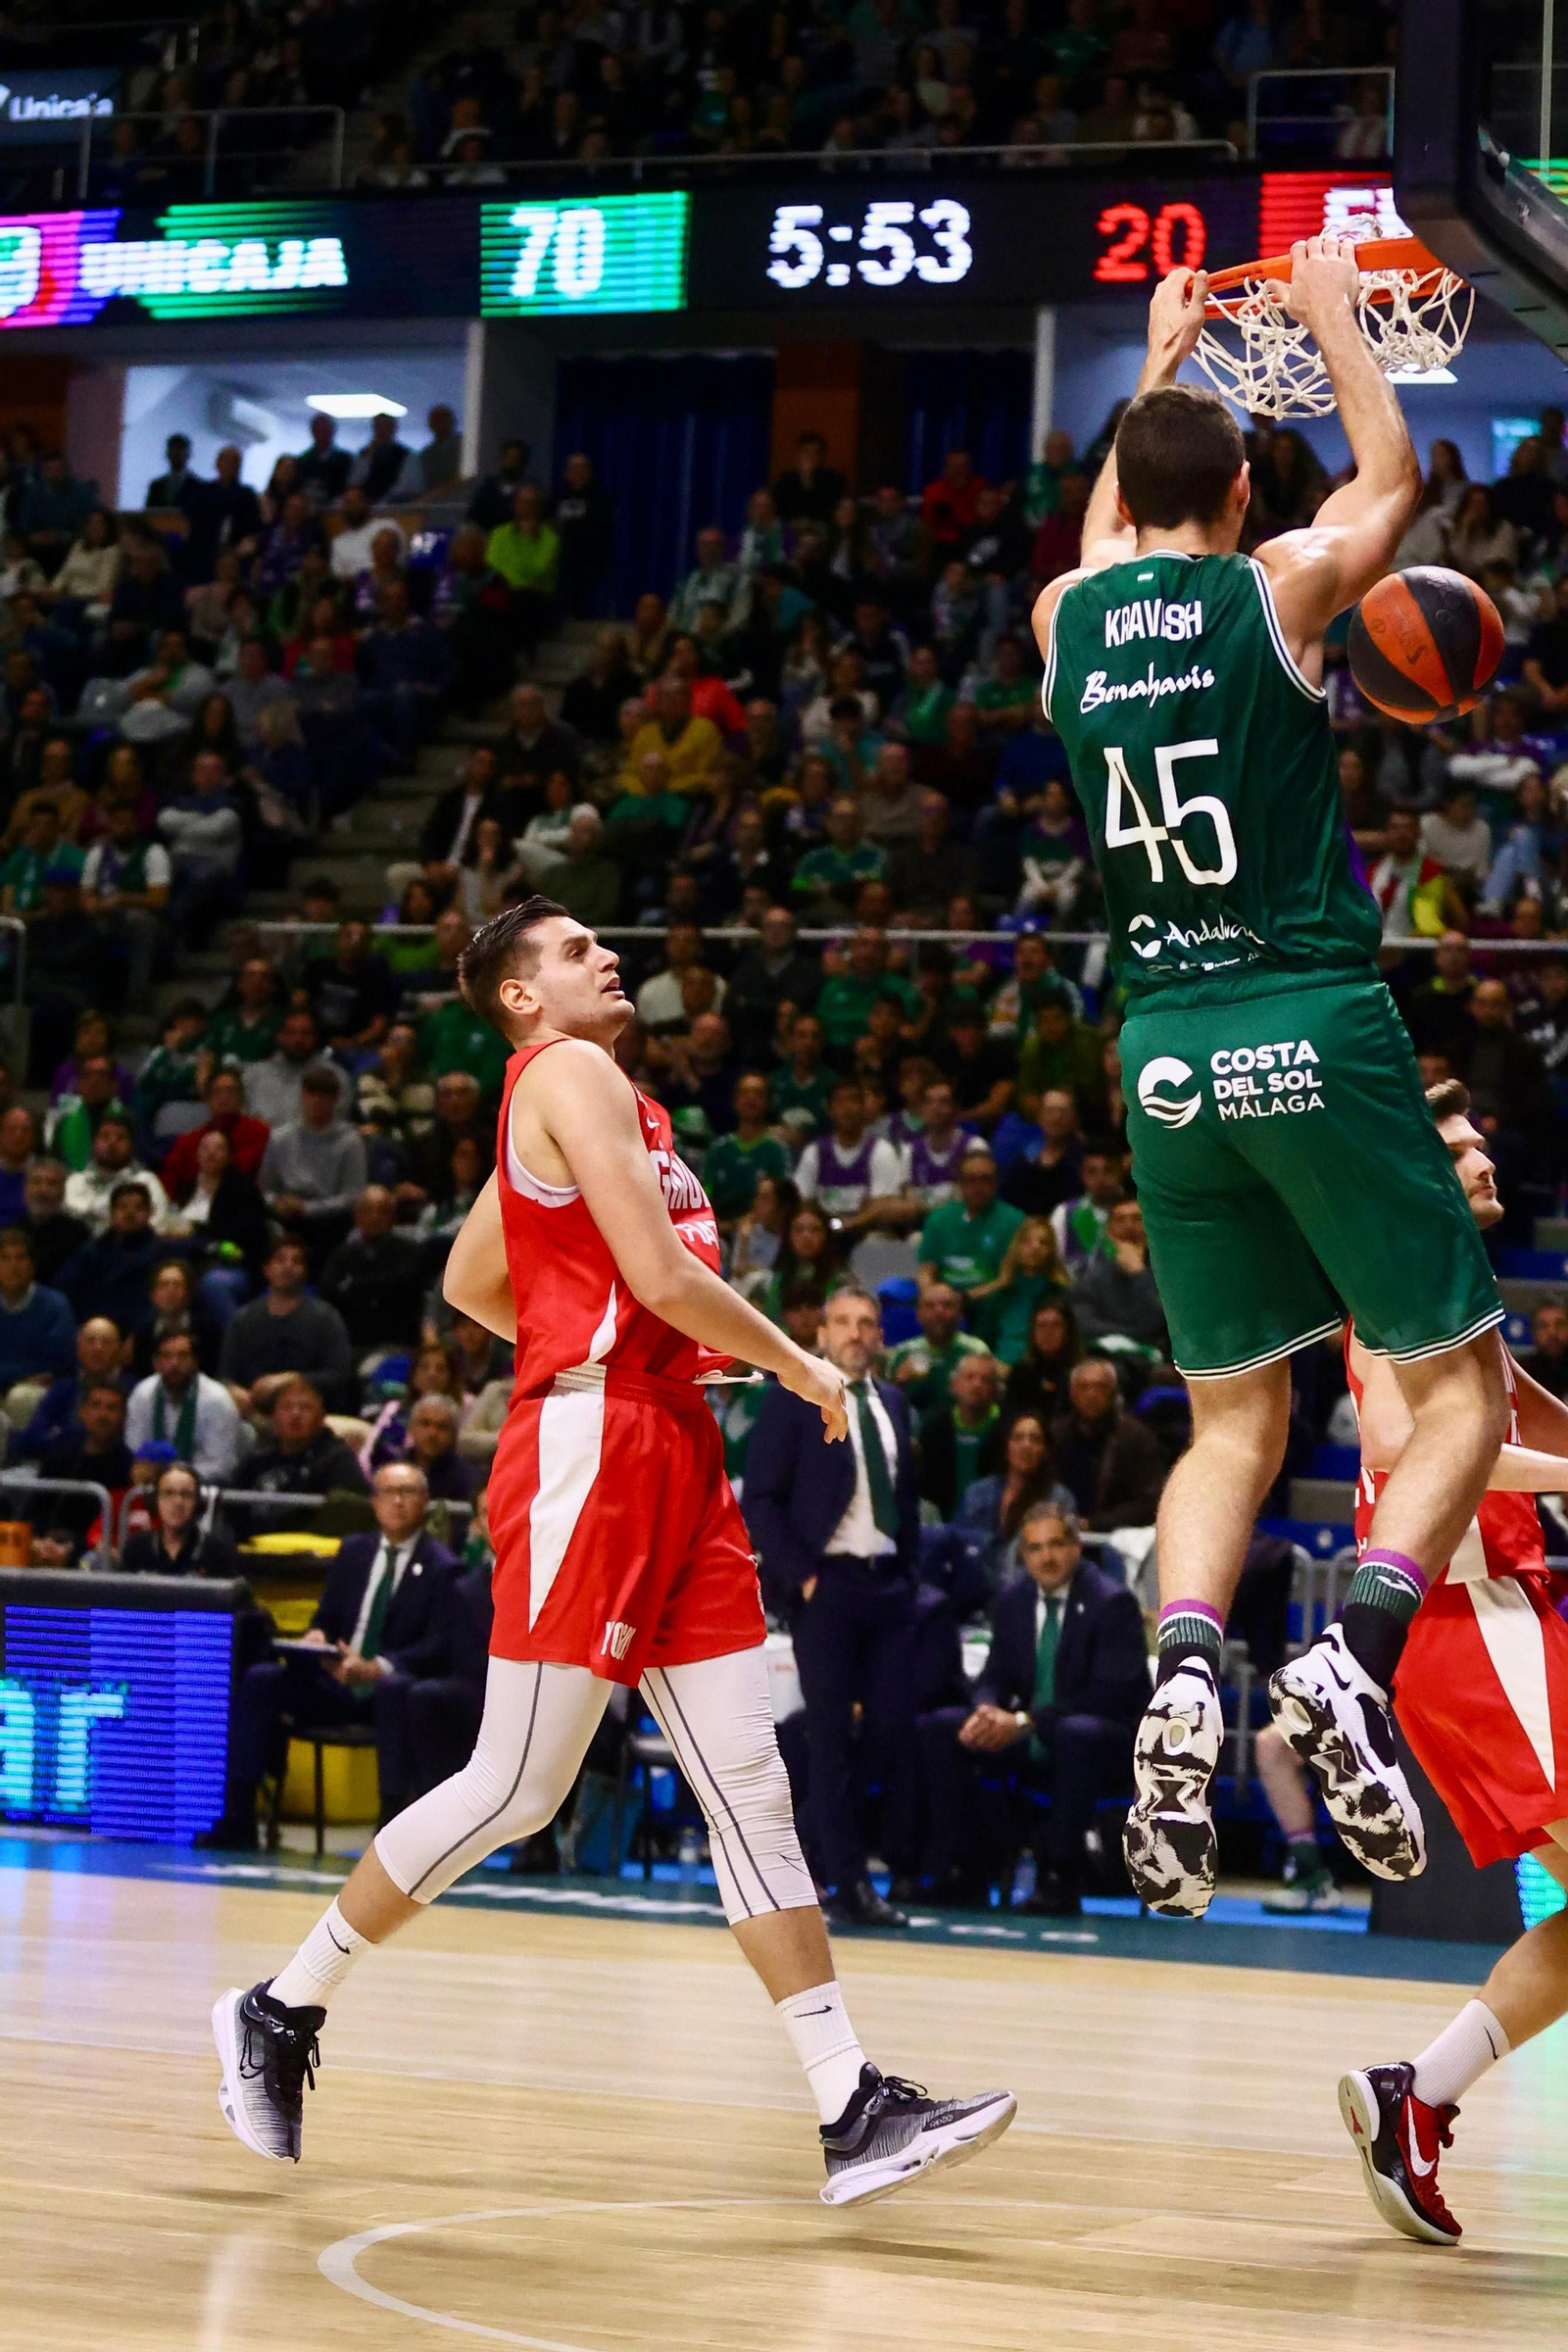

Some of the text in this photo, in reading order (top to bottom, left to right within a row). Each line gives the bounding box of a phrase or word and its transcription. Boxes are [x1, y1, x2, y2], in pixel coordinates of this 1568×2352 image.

[509, 207, 605, 298] 70
[767, 200, 973, 288] 5:53
[1094, 203, 1206, 281] 20
[1103, 738, 1238, 886] 45
[1210, 1039, 1320, 1075] COSTA
[1213, 1068, 1323, 1100] DEL SOL
[1217, 1092, 1326, 1121] MÁLAGA
